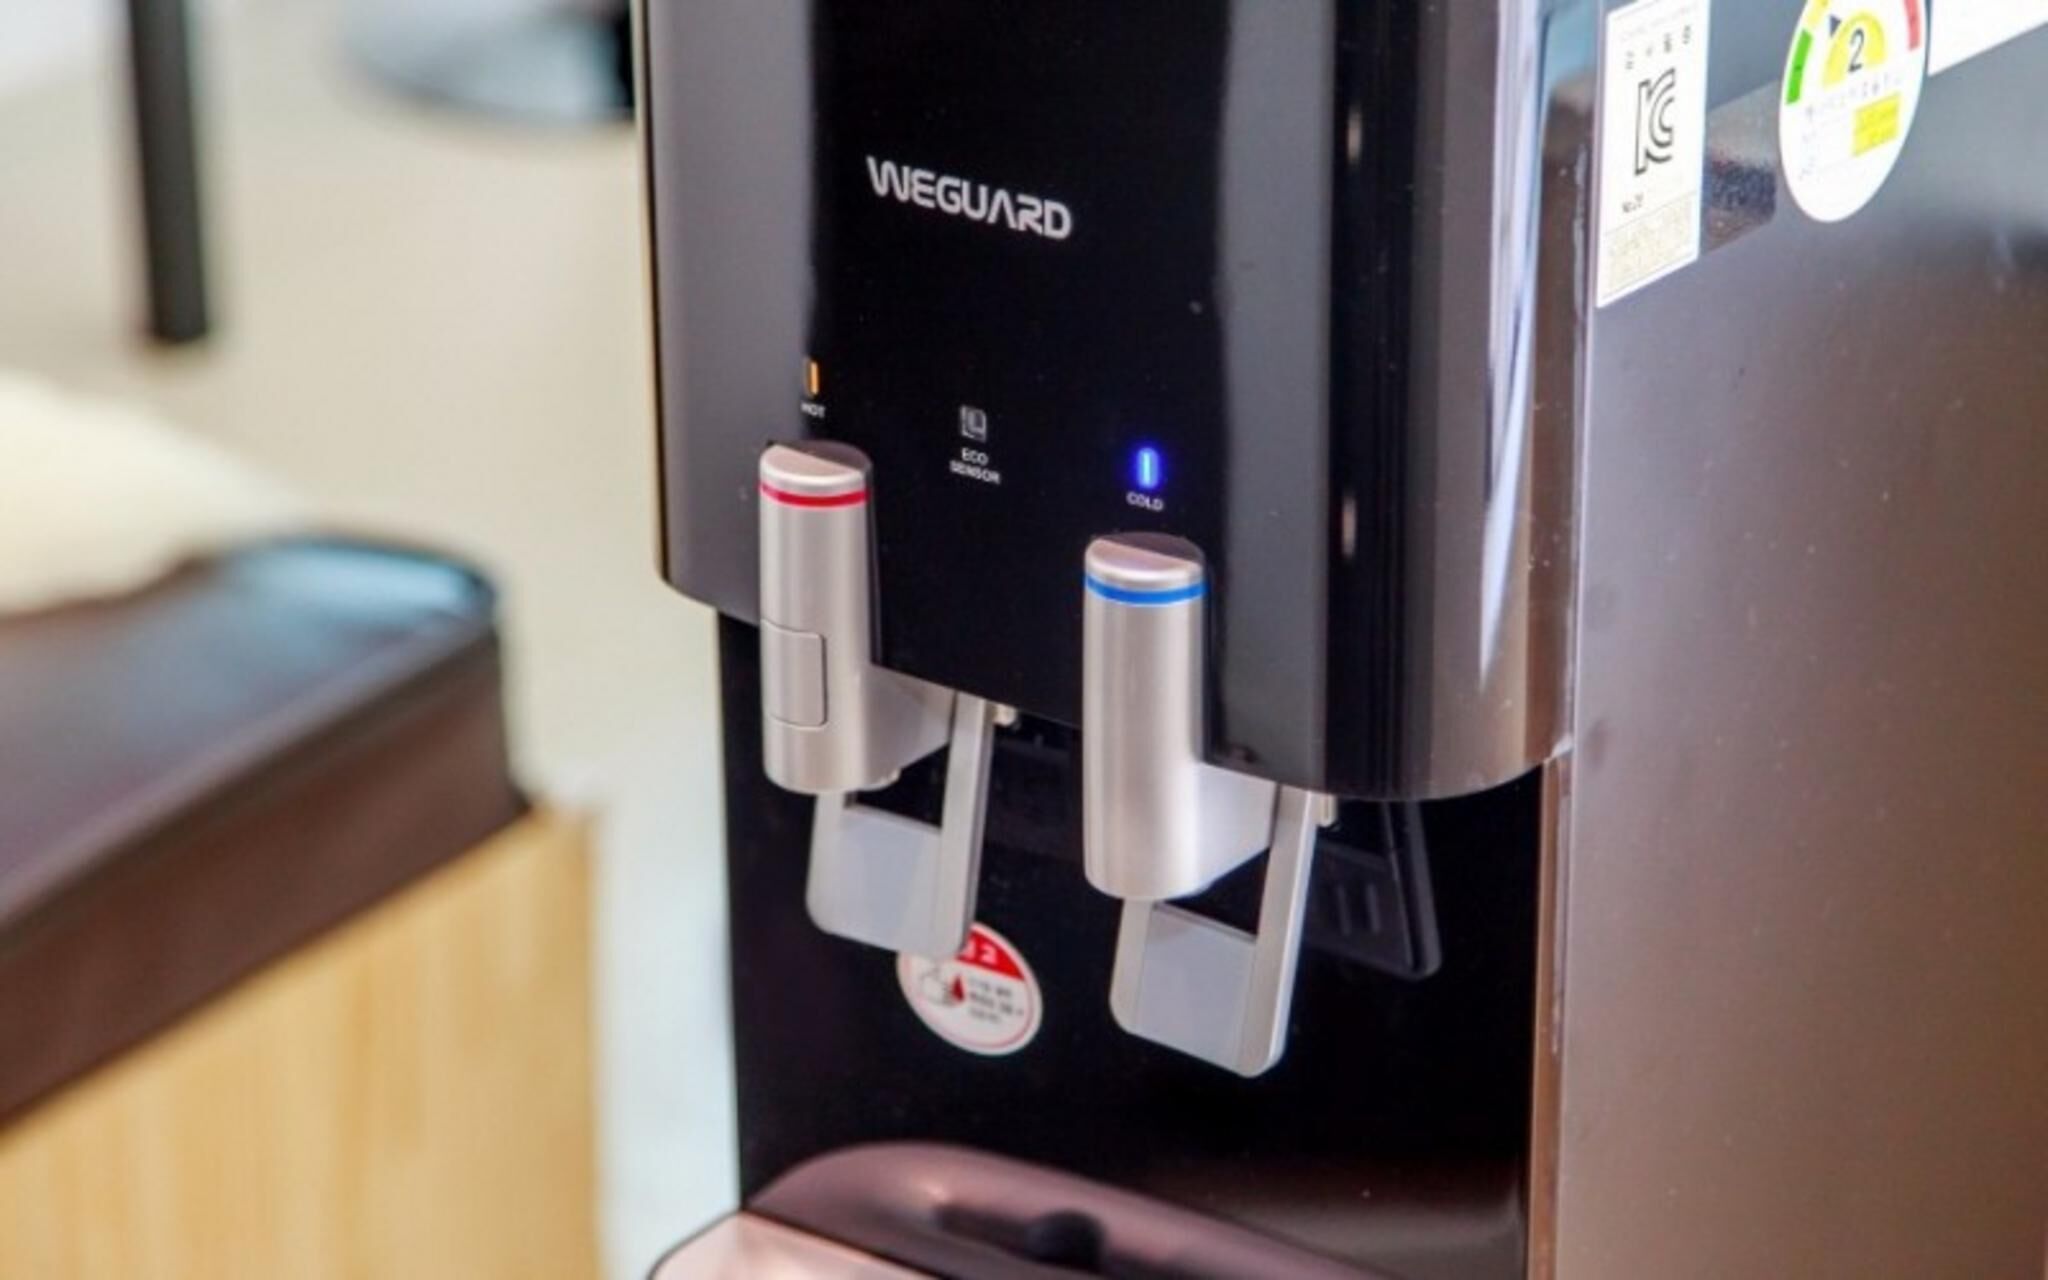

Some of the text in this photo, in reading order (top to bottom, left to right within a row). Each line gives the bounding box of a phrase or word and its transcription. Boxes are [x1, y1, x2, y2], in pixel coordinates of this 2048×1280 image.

[1848, 27, 1864, 73] 2
[866, 155, 1072, 239] WEGUARD
[801, 402, 825, 418] HOT
[962, 448, 989, 466] ECO
[950, 460, 1000, 484] SENSOR
[1126, 491, 1164, 511] COLD
